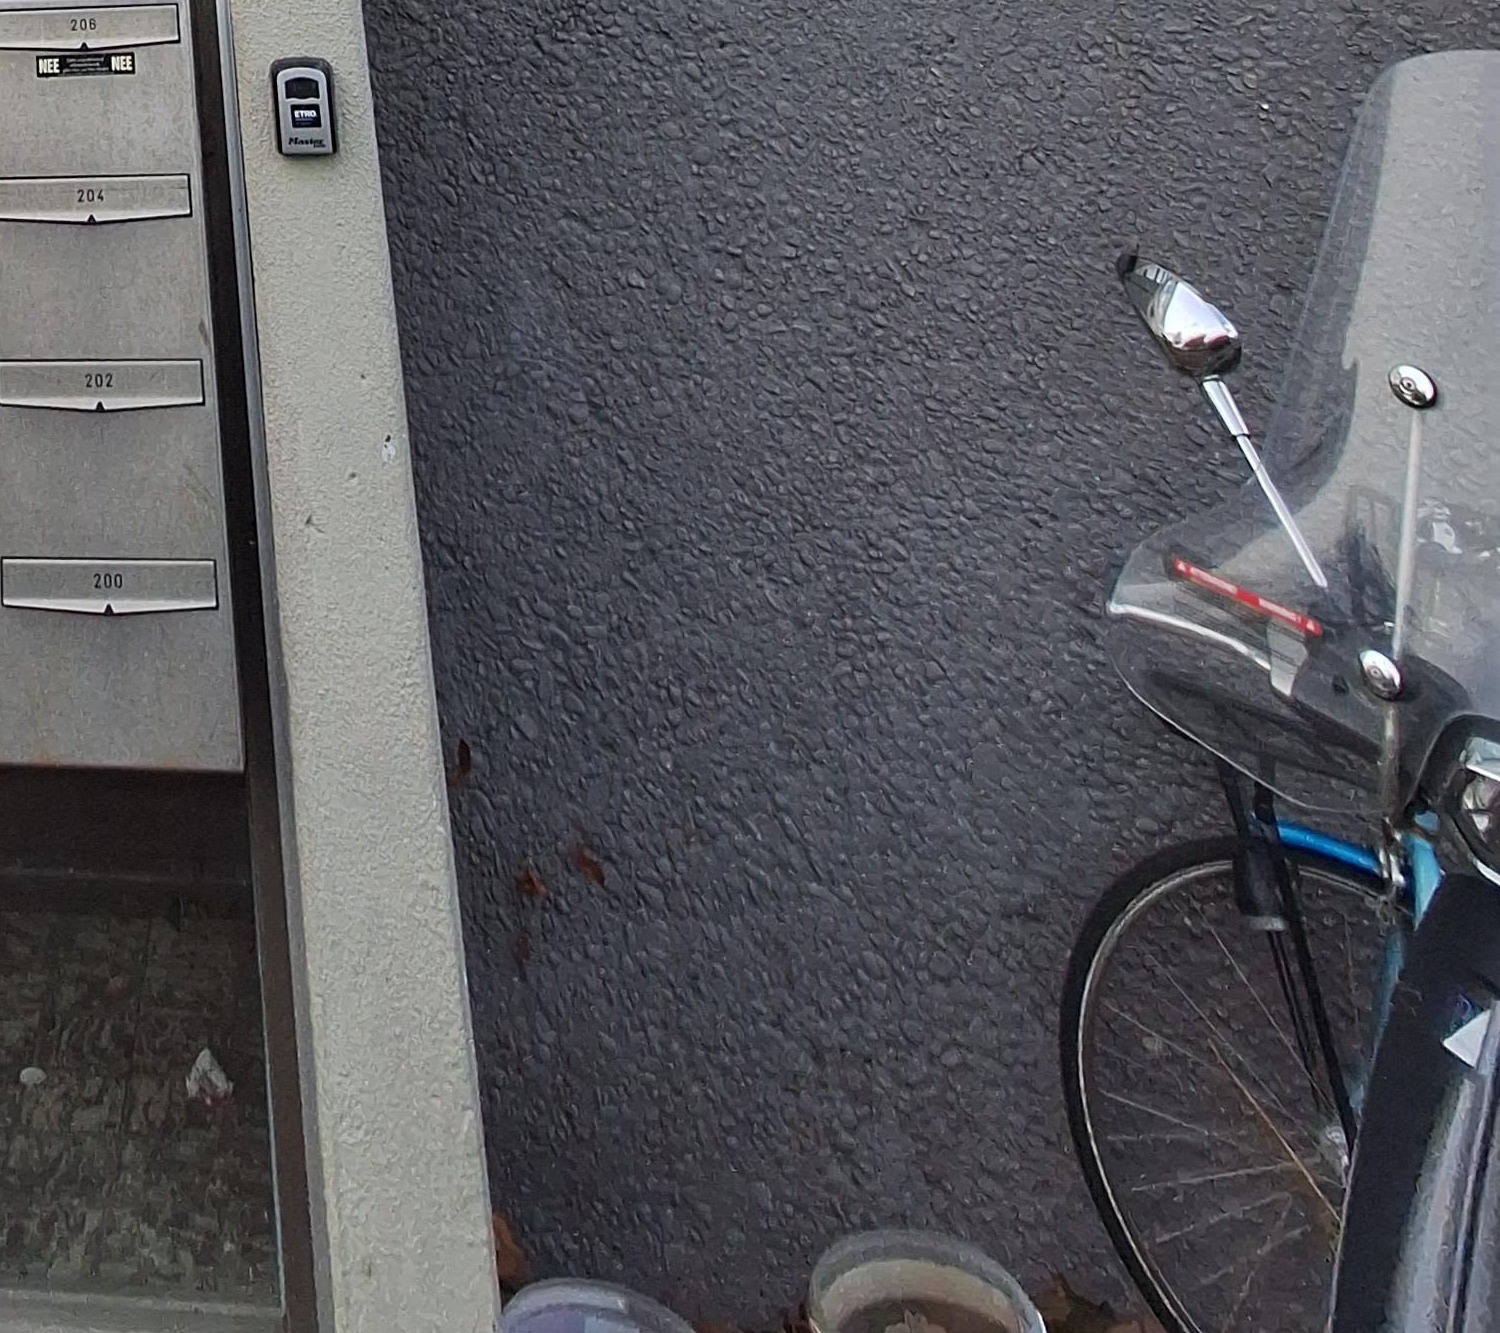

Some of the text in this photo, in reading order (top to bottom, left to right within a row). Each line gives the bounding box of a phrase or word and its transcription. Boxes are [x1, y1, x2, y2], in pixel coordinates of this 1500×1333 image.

[69, 17, 97, 32] 206
[38, 58, 61, 74] NEE
[110, 55, 134, 72] NEE
[76, 188, 104, 203] 204
[84, 372, 113, 389] 202
[93, 572, 123, 590] 200
